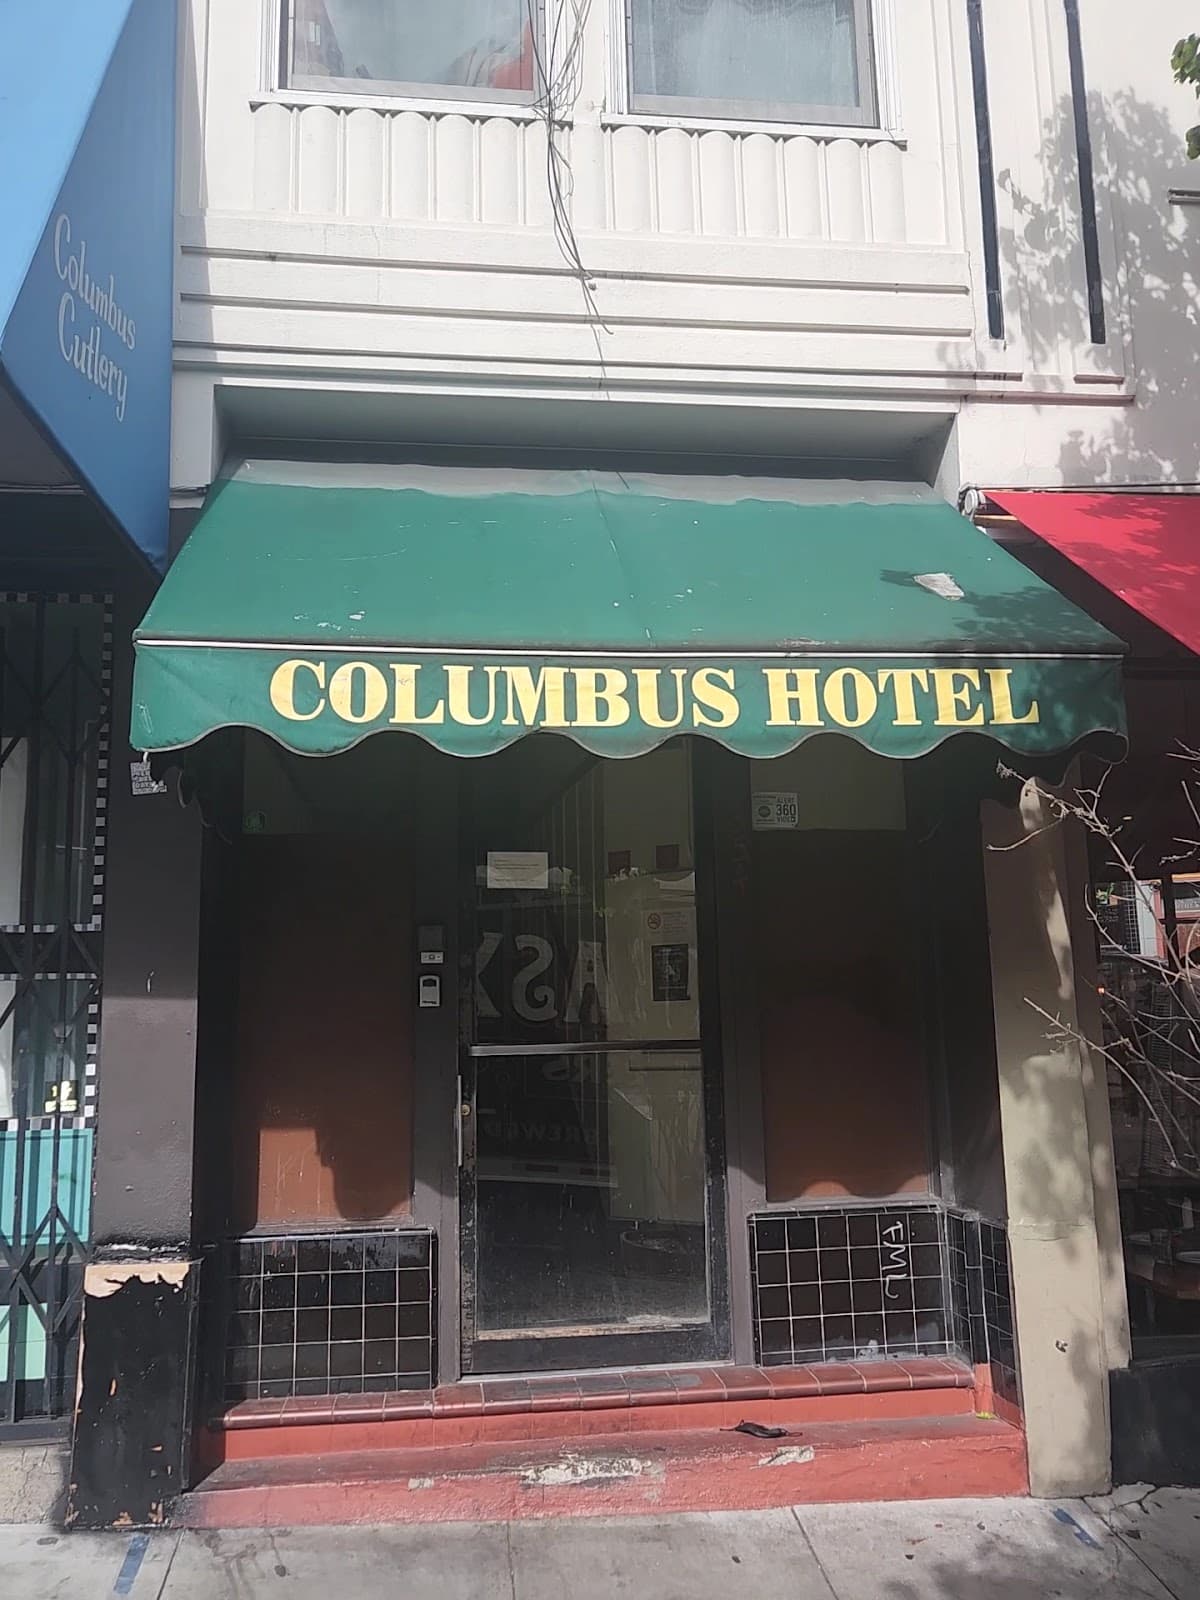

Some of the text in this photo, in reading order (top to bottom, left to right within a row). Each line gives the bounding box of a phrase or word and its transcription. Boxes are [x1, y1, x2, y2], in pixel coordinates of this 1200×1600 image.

[54, 213, 136, 350] Columbus
[58, 292, 128, 422] Cutlery
[269, 658, 1041, 729] COLUMBUS HOTEL
[775, 803, 797, 817] 360
